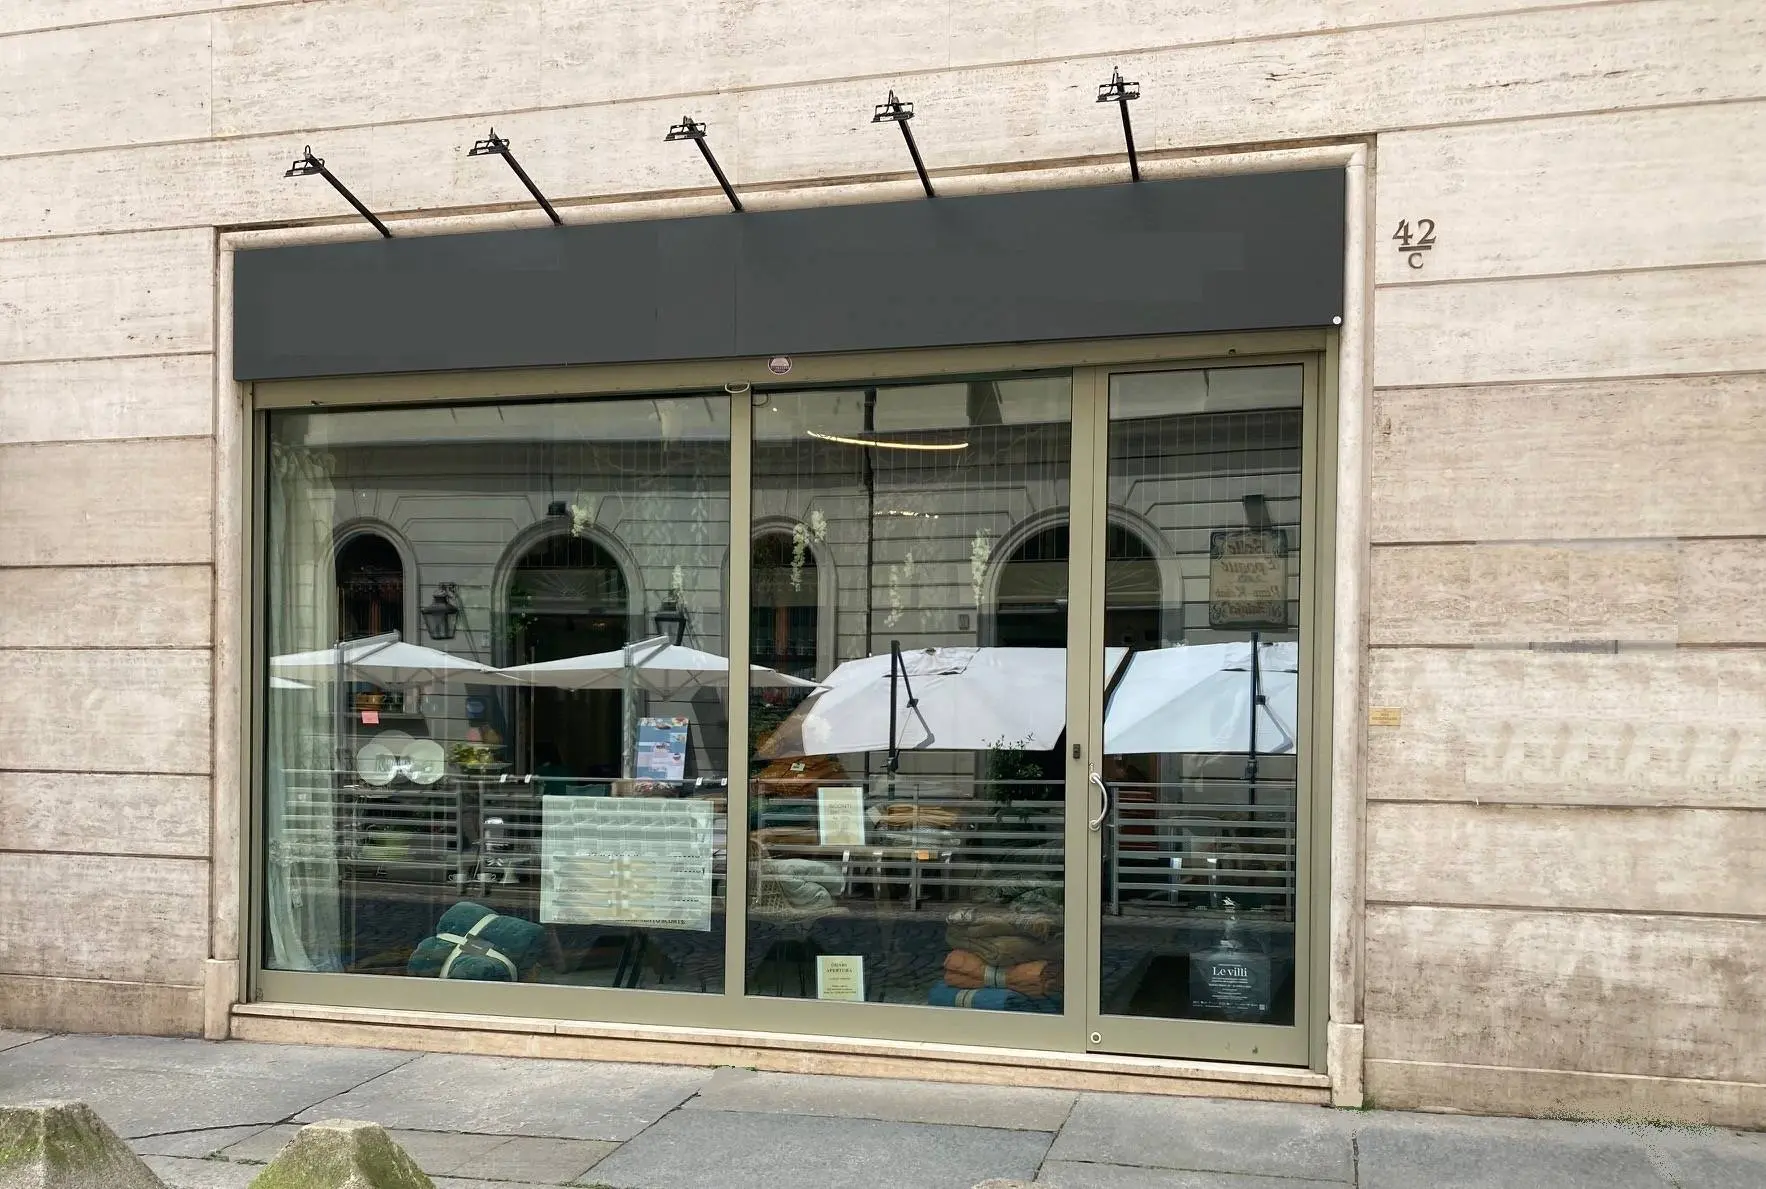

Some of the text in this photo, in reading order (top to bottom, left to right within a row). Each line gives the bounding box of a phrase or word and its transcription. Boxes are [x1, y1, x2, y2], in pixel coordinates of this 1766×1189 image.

[1392, 218, 1437, 246] 42
[1408, 252, 1424, 270] C
[1212, 966, 1248, 977] Le villi
